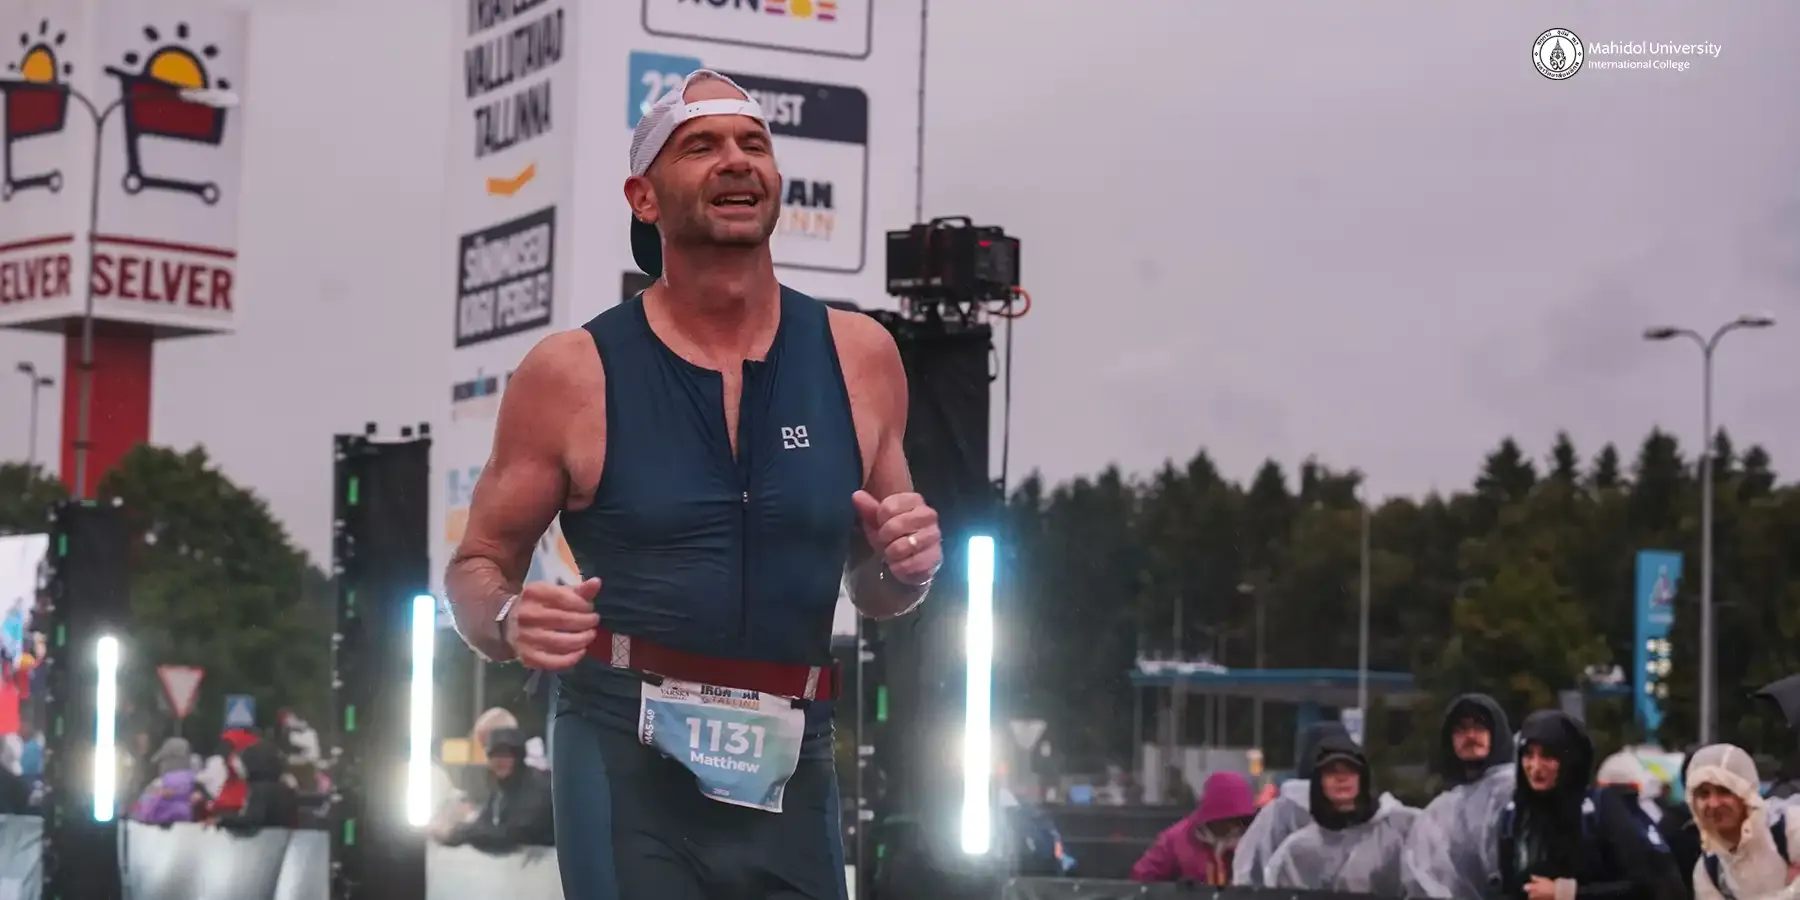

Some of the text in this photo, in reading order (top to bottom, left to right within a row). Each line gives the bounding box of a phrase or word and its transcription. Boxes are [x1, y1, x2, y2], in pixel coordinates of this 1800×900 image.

[0, 254, 71, 304] ELVER
[92, 254, 233, 312] SELVER
[644, 709, 656, 745] M45-49
[686, 717, 766, 759] 1131
[690, 751, 760, 774] Matthew
